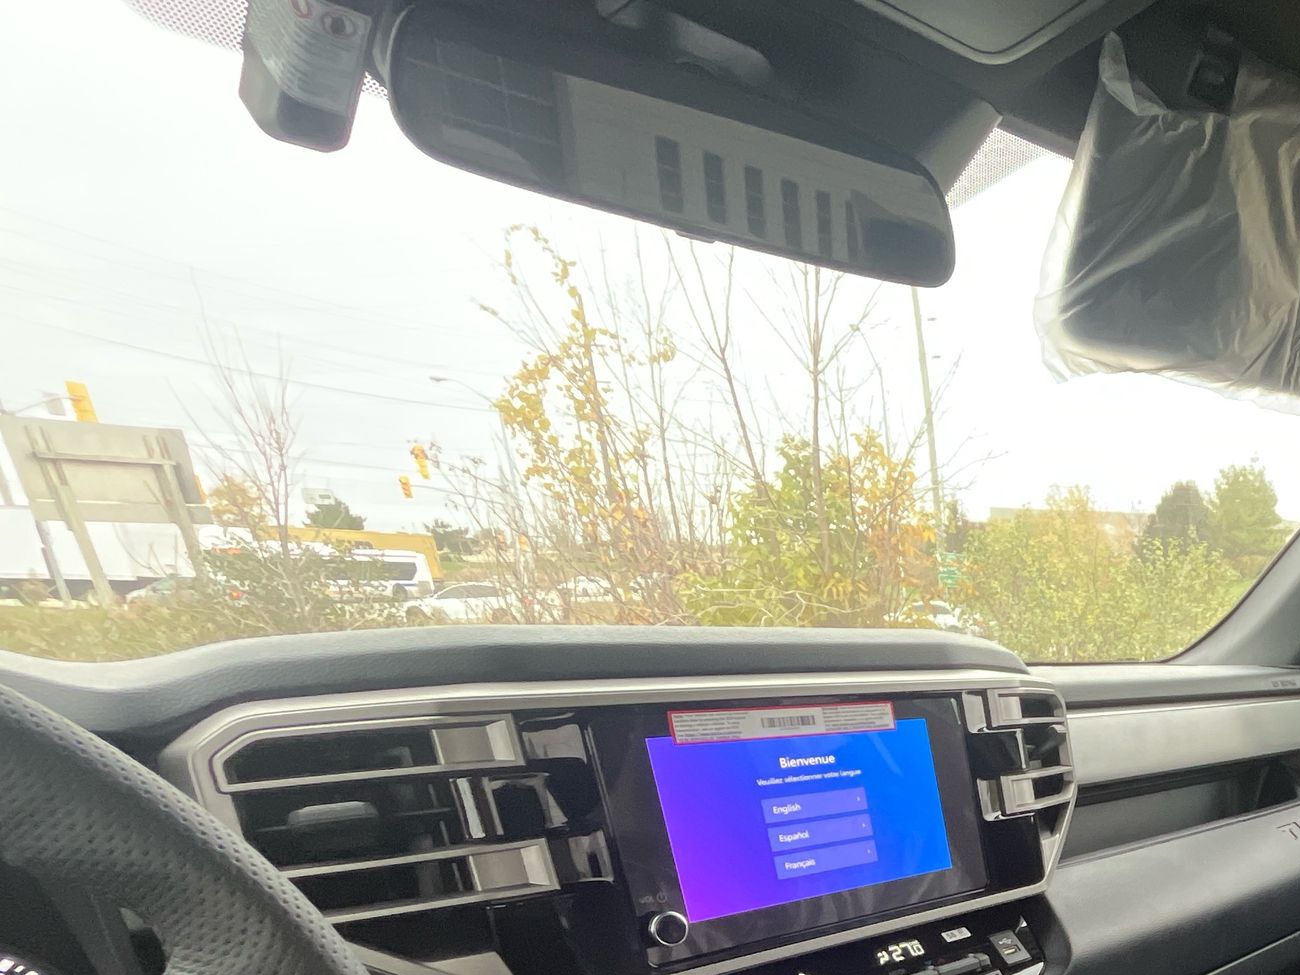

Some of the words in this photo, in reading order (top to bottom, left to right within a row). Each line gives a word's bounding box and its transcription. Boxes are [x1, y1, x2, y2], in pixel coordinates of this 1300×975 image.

[779, 755, 836, 769] Bienvenue
[839, 768, 862, 778] langue
[772, 803, 802, 815] English
[778, 830, 810, 843] Español
[784, 858, 816, 871] Français
